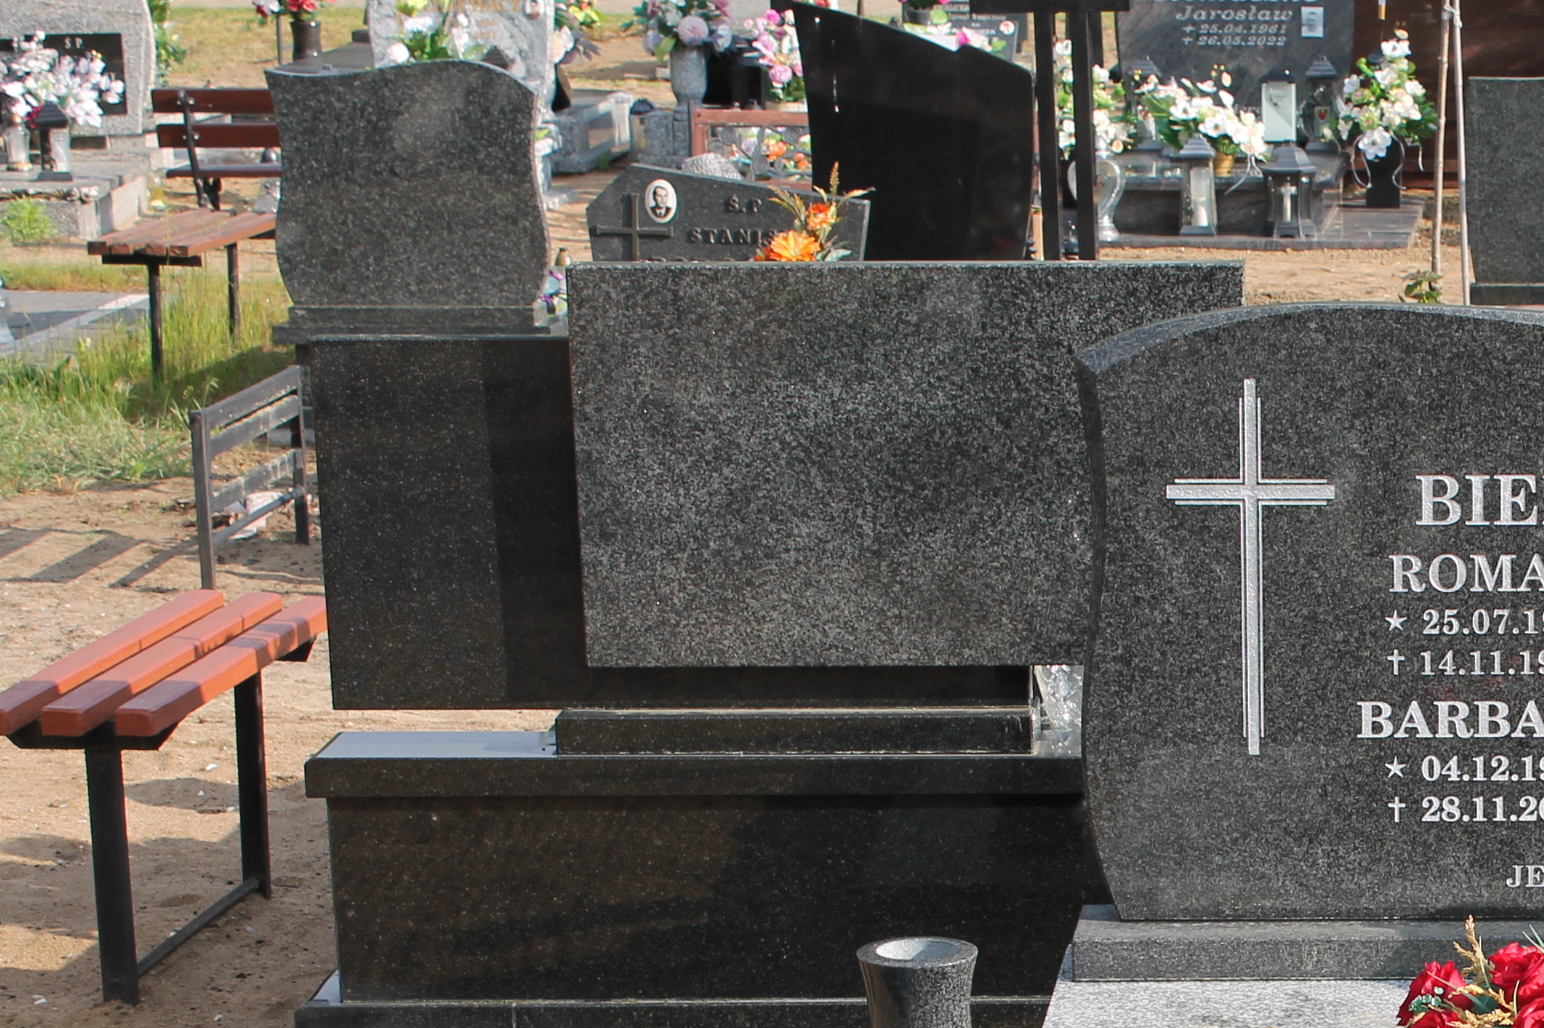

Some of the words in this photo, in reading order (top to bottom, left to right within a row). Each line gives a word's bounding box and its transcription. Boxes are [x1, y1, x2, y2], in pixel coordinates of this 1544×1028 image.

[1175, 5, 1293, 21] Jarosław
[1199, 24, 1288, 34] 25.04.1961
[1197, 35, 1287, 46] 26.05.2022
